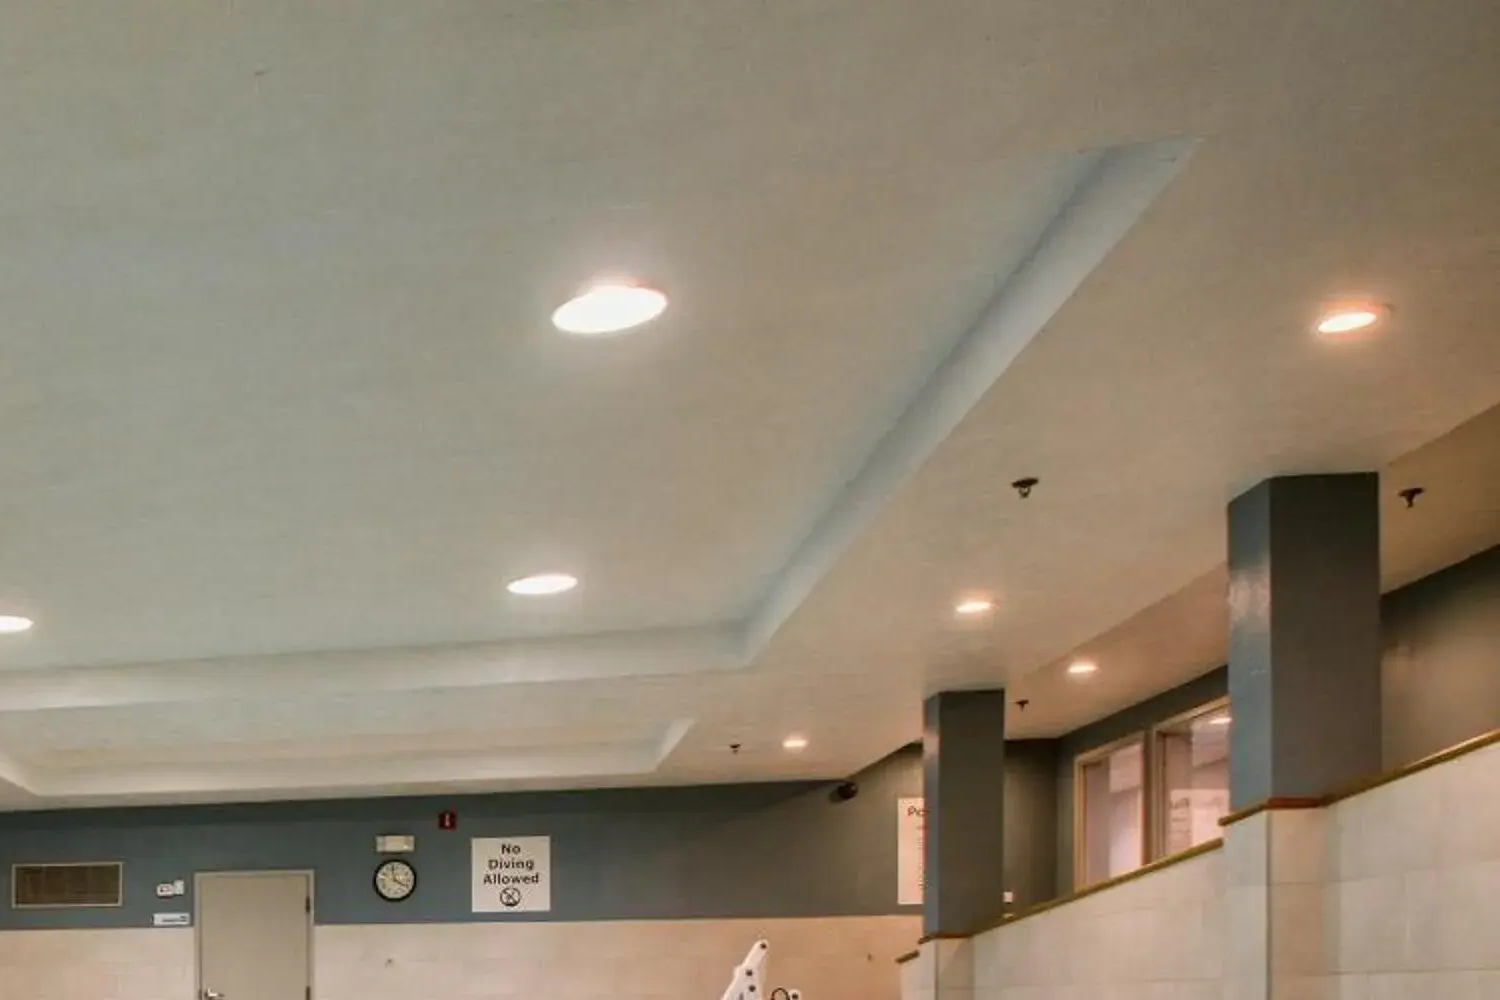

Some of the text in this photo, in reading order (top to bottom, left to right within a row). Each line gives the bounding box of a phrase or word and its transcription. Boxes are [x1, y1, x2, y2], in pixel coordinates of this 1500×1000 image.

[501, 844, 521, 854] No
[487, 858, 535, 870] Diving
[483, 873, 540, 885] Allowed
